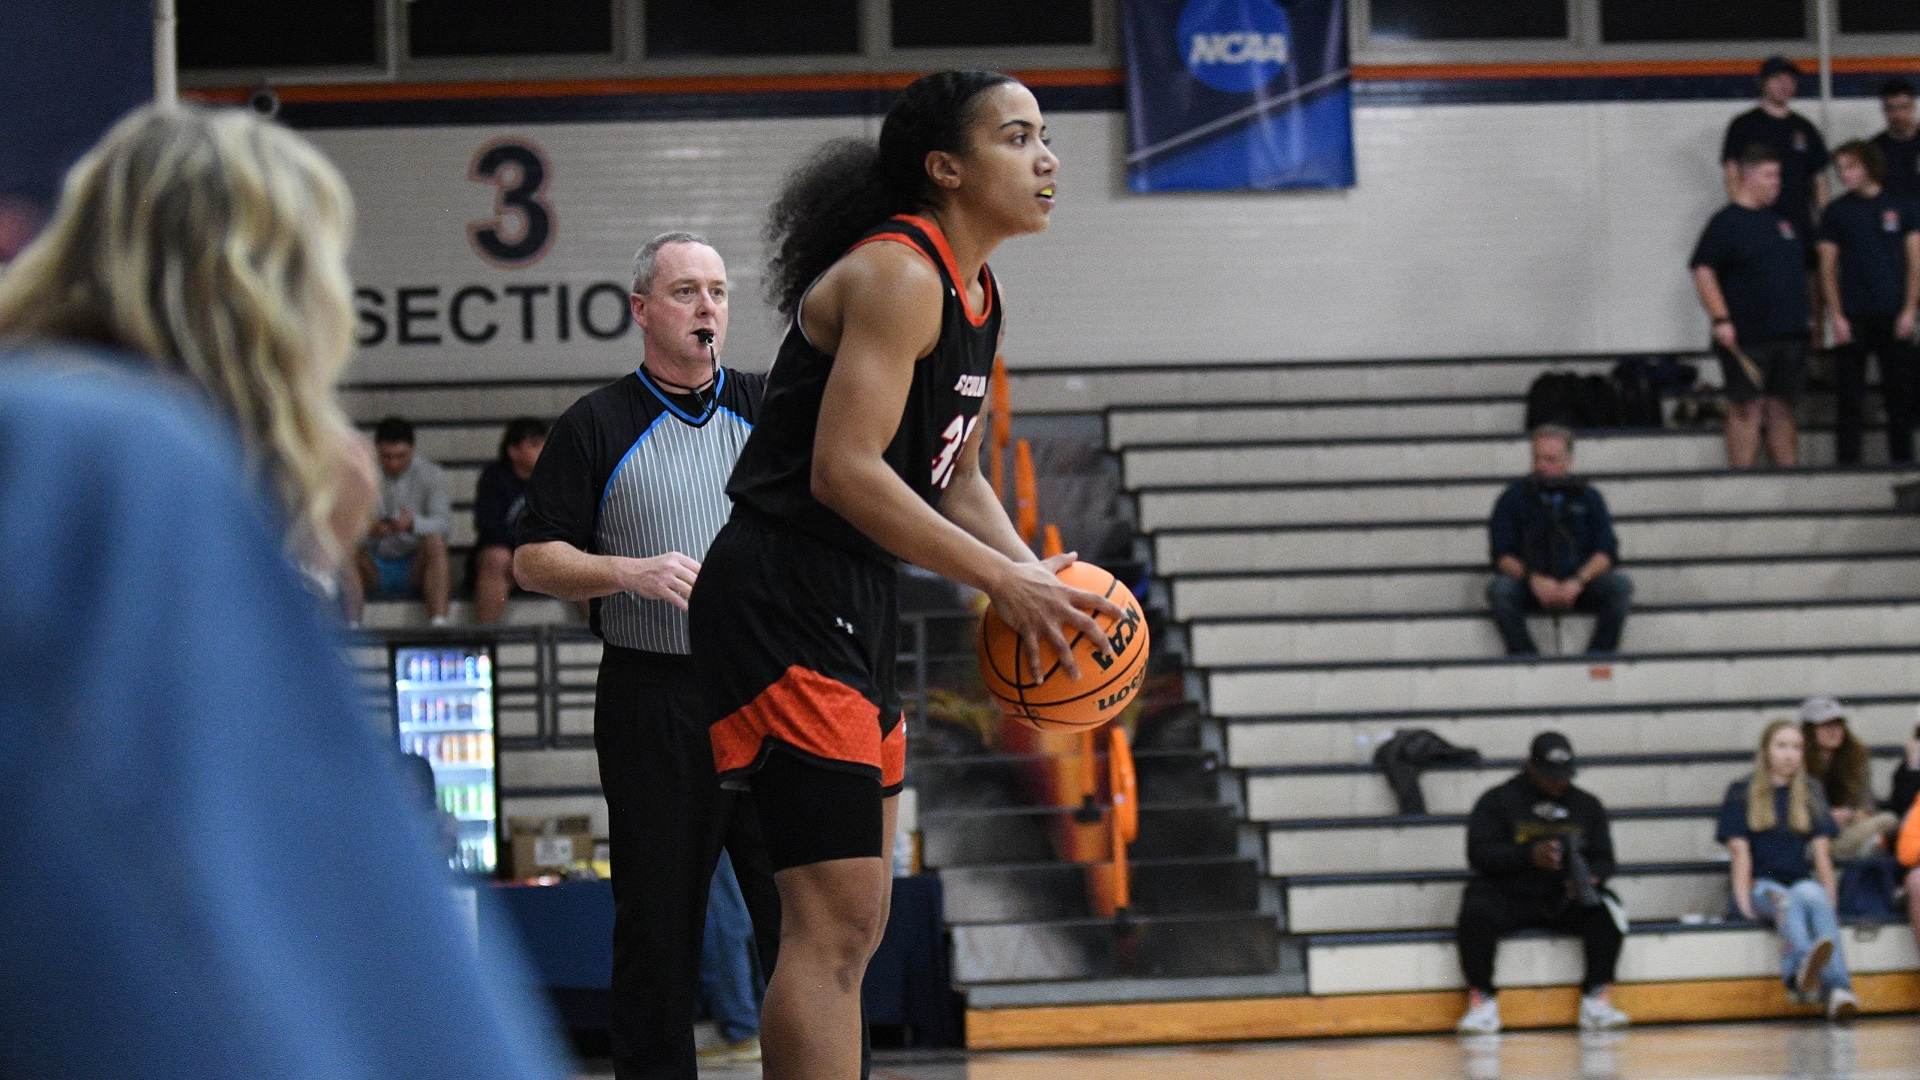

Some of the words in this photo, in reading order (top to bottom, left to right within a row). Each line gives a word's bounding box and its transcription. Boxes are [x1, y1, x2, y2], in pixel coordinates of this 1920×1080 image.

[1189, 32, 1288, 65] NCAA
[467, 137, 558, 270] 3
[354, 281, 634, 348] SECTIO
[931, 414, 978, 489] 3
